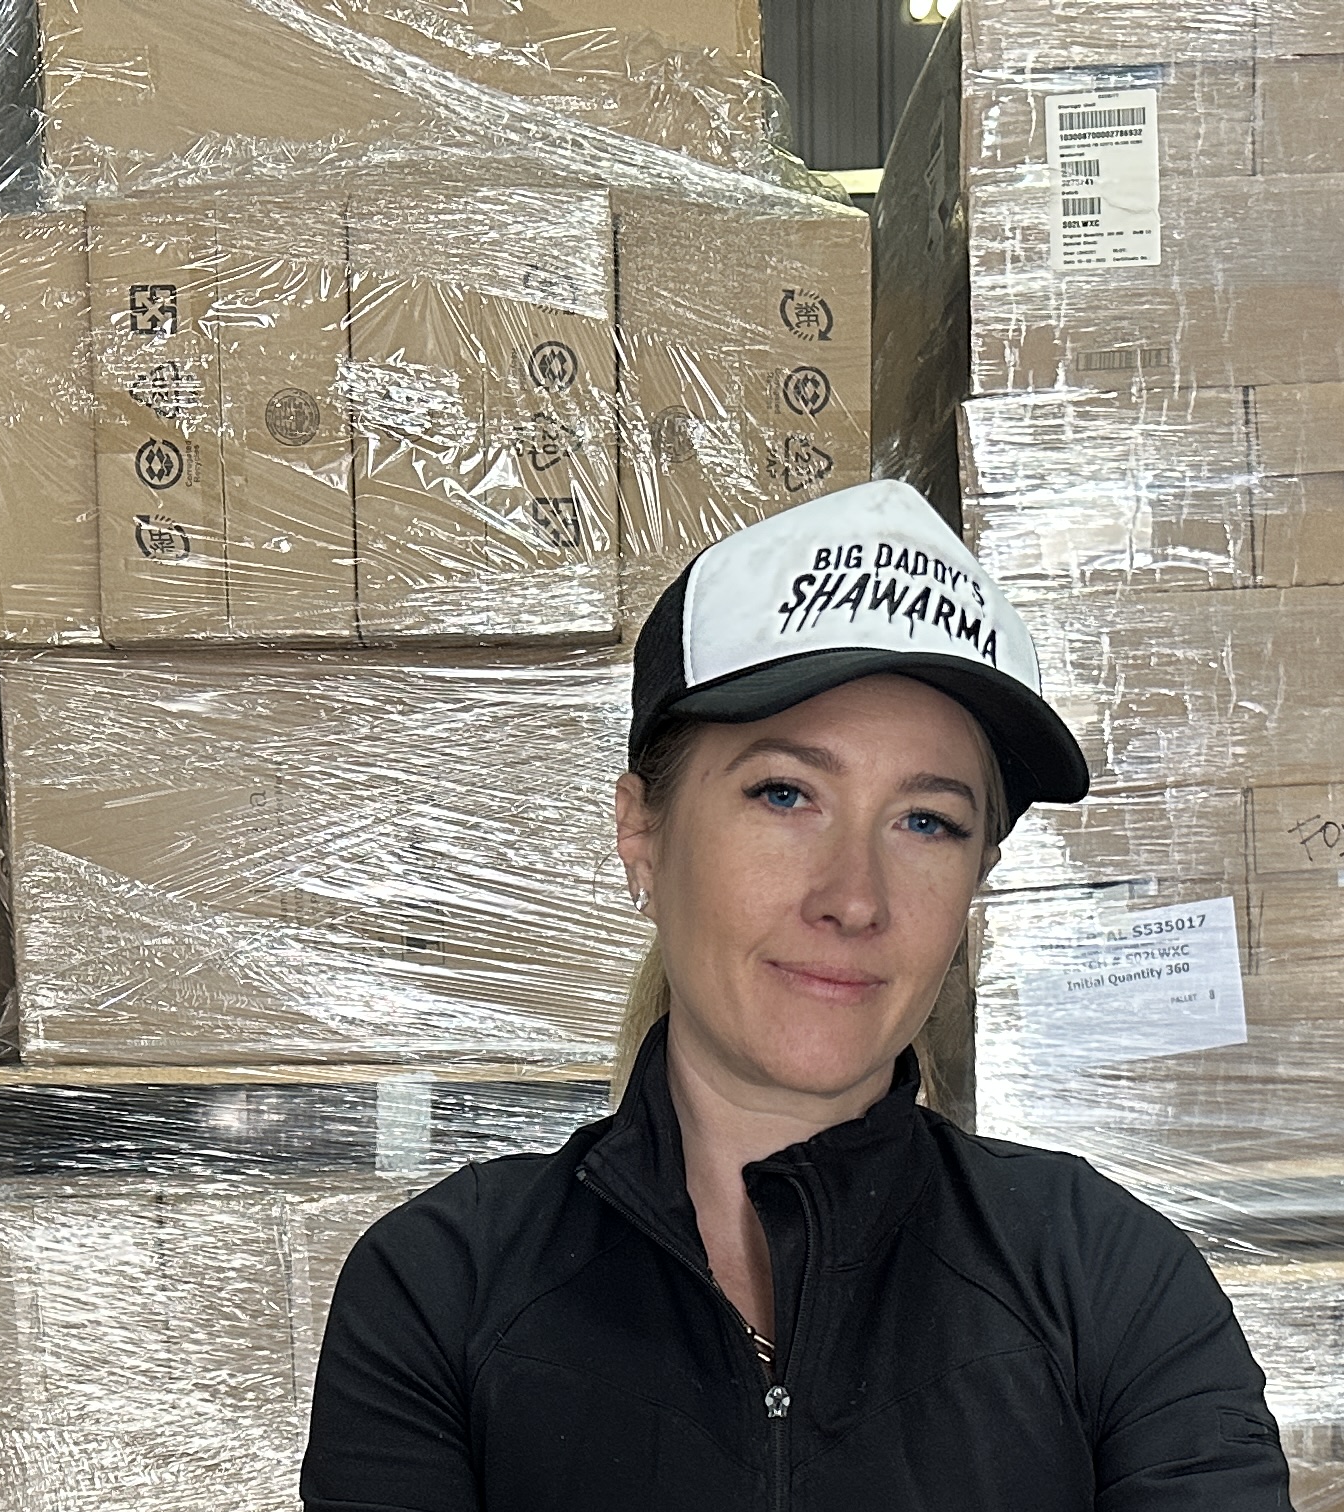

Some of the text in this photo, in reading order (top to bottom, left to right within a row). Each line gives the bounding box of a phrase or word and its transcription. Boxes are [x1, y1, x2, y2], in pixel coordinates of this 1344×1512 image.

[812, 543, 985, 606] BIG DADDY'S
[778, 573, 997, 669] SHAWARMA
[1132, 914, 1206, 939] S535017
[1066, 962, 1190, 992] Initial Quantity 360
